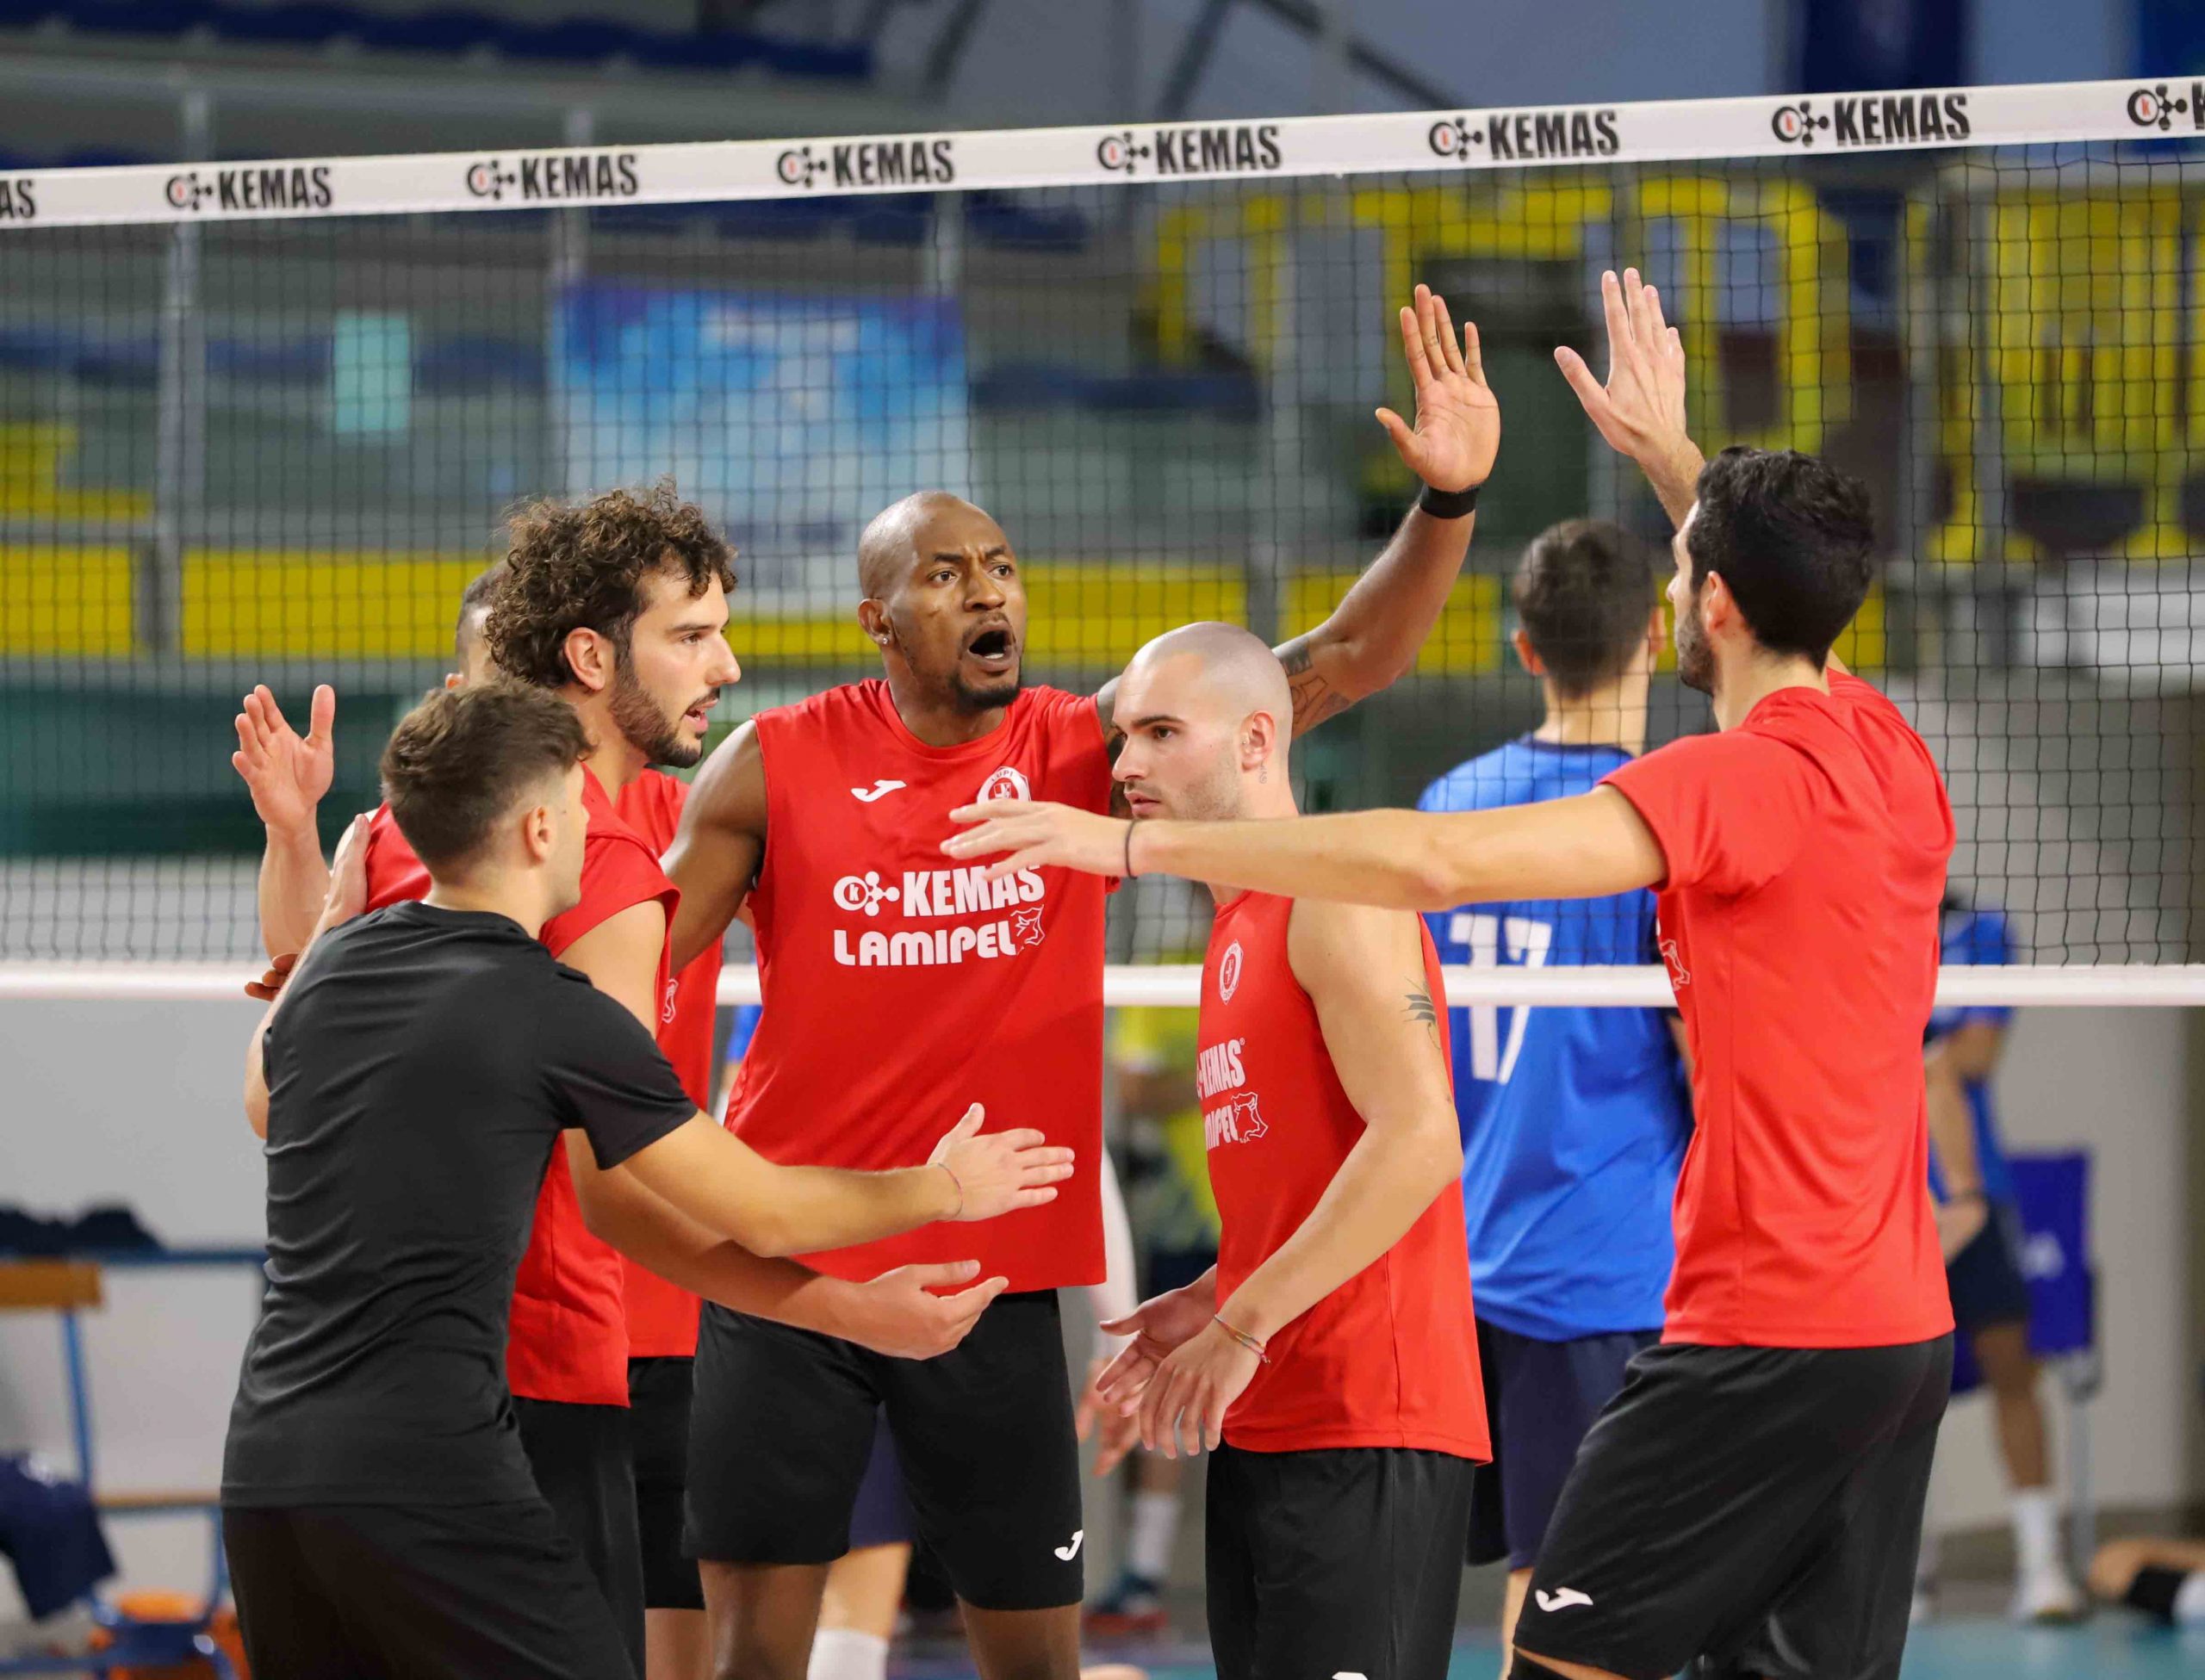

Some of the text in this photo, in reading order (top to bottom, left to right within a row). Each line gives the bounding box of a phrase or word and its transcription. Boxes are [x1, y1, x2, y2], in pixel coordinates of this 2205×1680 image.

[1488, 109, 1619, 159] KEMAS
[1835, 93, 1971, 146] KEMAS
[834, 140, 954, 187] KEMAS
[1155, 126, 1281, 174] KEMAS
[220, 167, 332, 209] KEMAS
[522, 154, 638, 199] KEMAS
[903, 861, 1045, 917] KEMAS
[834, 921, 1016, 966] LAMIPEL
[1449, 913, 1551, 1085] 17
